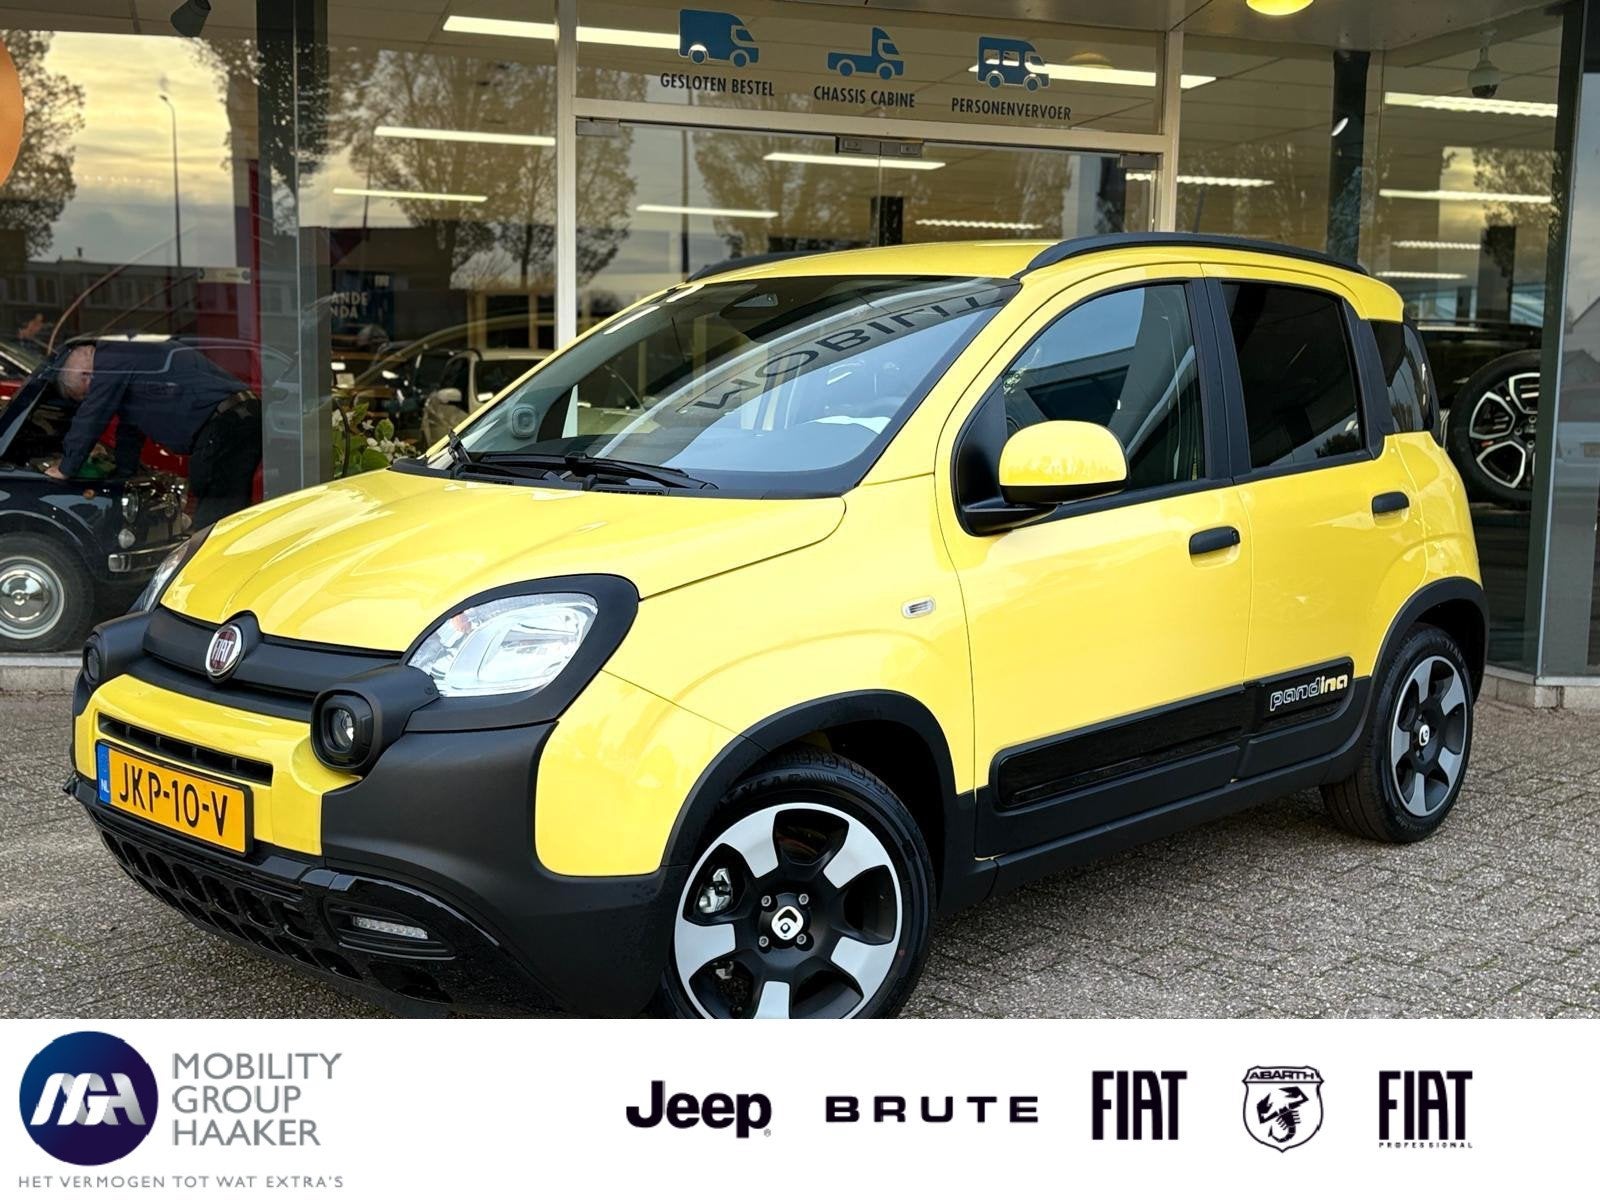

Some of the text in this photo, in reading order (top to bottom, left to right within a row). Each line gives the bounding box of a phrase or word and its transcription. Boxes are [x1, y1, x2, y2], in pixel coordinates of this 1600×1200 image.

[661, 73, 775, 97] GESLOTEN BESTEL
[814, 86, 915, 108] CHASSIS CABINE
[951, 98, 1071, 121] PERSONENVERVOER
[331, 291, 368, 305] ANDE
[330, 305, 359, 319] NDA
[211, 638, 234, 663] FIAT
[101, 778, 110, 793] NL
[120, 762, 228, 837] JKP-10-V
